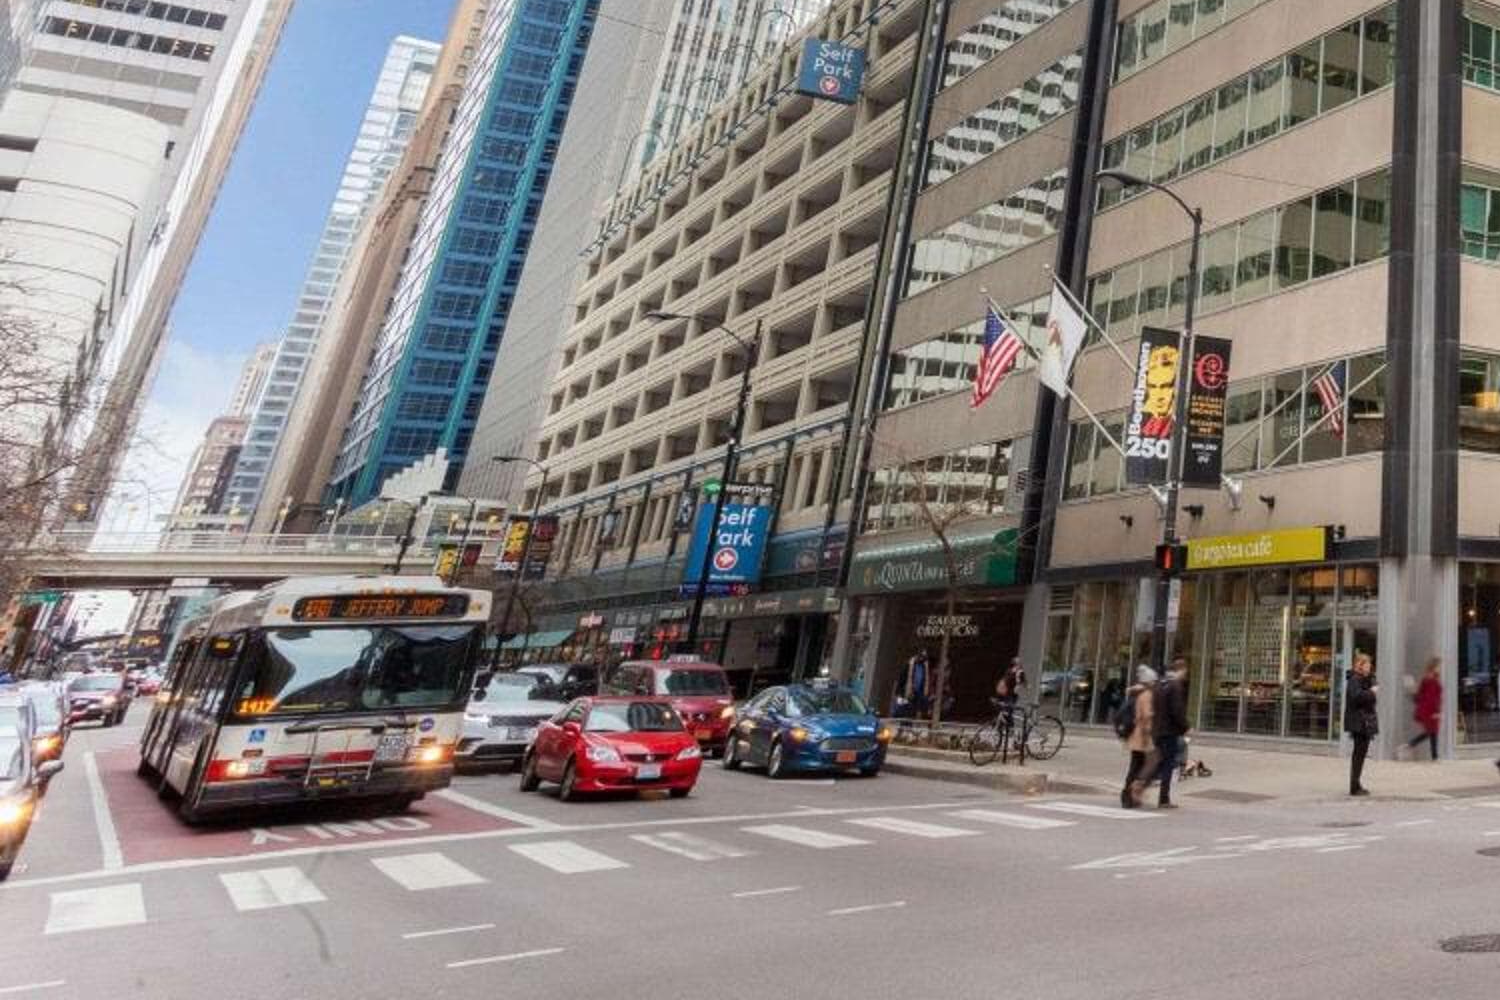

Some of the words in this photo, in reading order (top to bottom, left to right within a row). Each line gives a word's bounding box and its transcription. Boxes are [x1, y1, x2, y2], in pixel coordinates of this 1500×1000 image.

[819, 42, 854, 61] Self
[813, 57, 853, 79] Park
[1128, 341, 1151, 436] Beethoven
[1126, 437, 1169, 459] 250
[716, 527, 755, 547] ark
[880, 560, 923, 590] QUINTA
[341, 599, 402, 618] JEFFERY
[408, 598, 445, 617] JUMP
[239, 700, 274, 713] 1417
